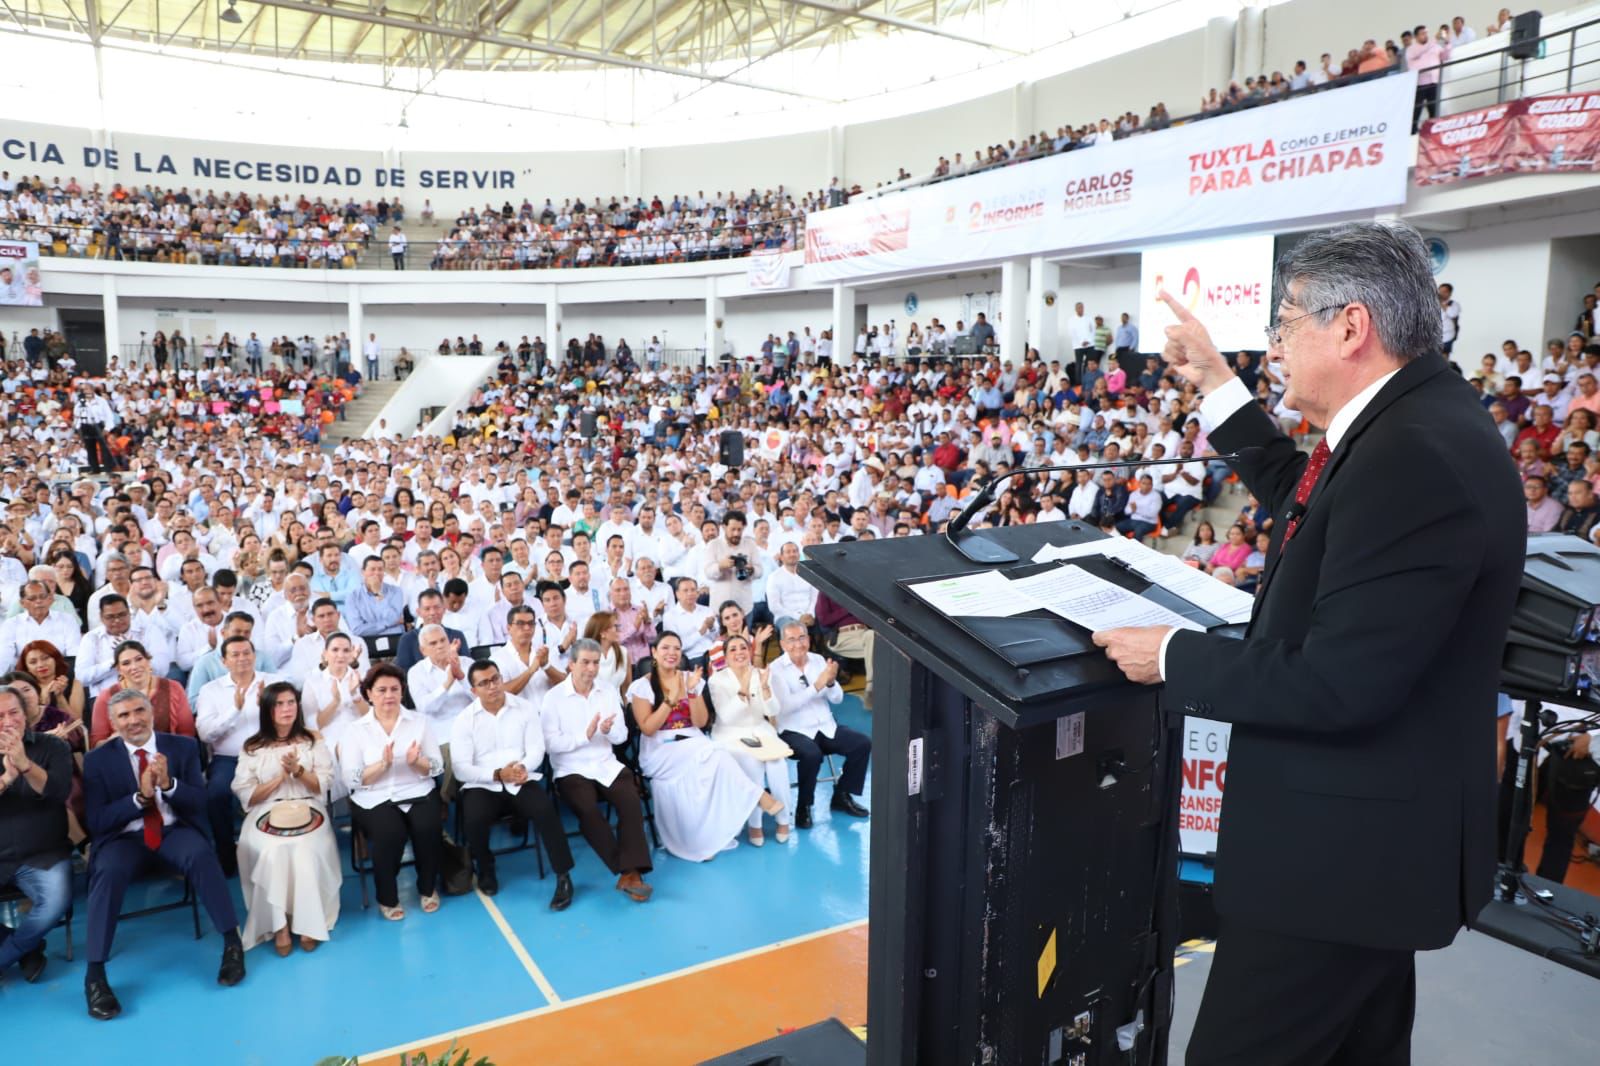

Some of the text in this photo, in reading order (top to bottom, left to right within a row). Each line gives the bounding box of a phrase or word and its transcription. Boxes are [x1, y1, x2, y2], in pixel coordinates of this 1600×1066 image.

[1538, 112, 1588, 129] CORZO
[1188, 121, 1388, 172] TUXTLA COMO EJEMPLO
[1440, 123, 1488, 145] CORZO
[2, 138, 65, 165] CIA
[83, 146, 119, 170] DE
[134, 152, 178, 175] LA
[193, 157, 362, 187] NECESIDAD
[375, 168, 405, 188] DE
[1189, 142, 1385, 196] PARA CHIAPAS
[1065, 169, 1134, 196] CARLOS
[1063, 188, 1132, 212] MORALES
[983, 202, 1044, 225] INFORME
